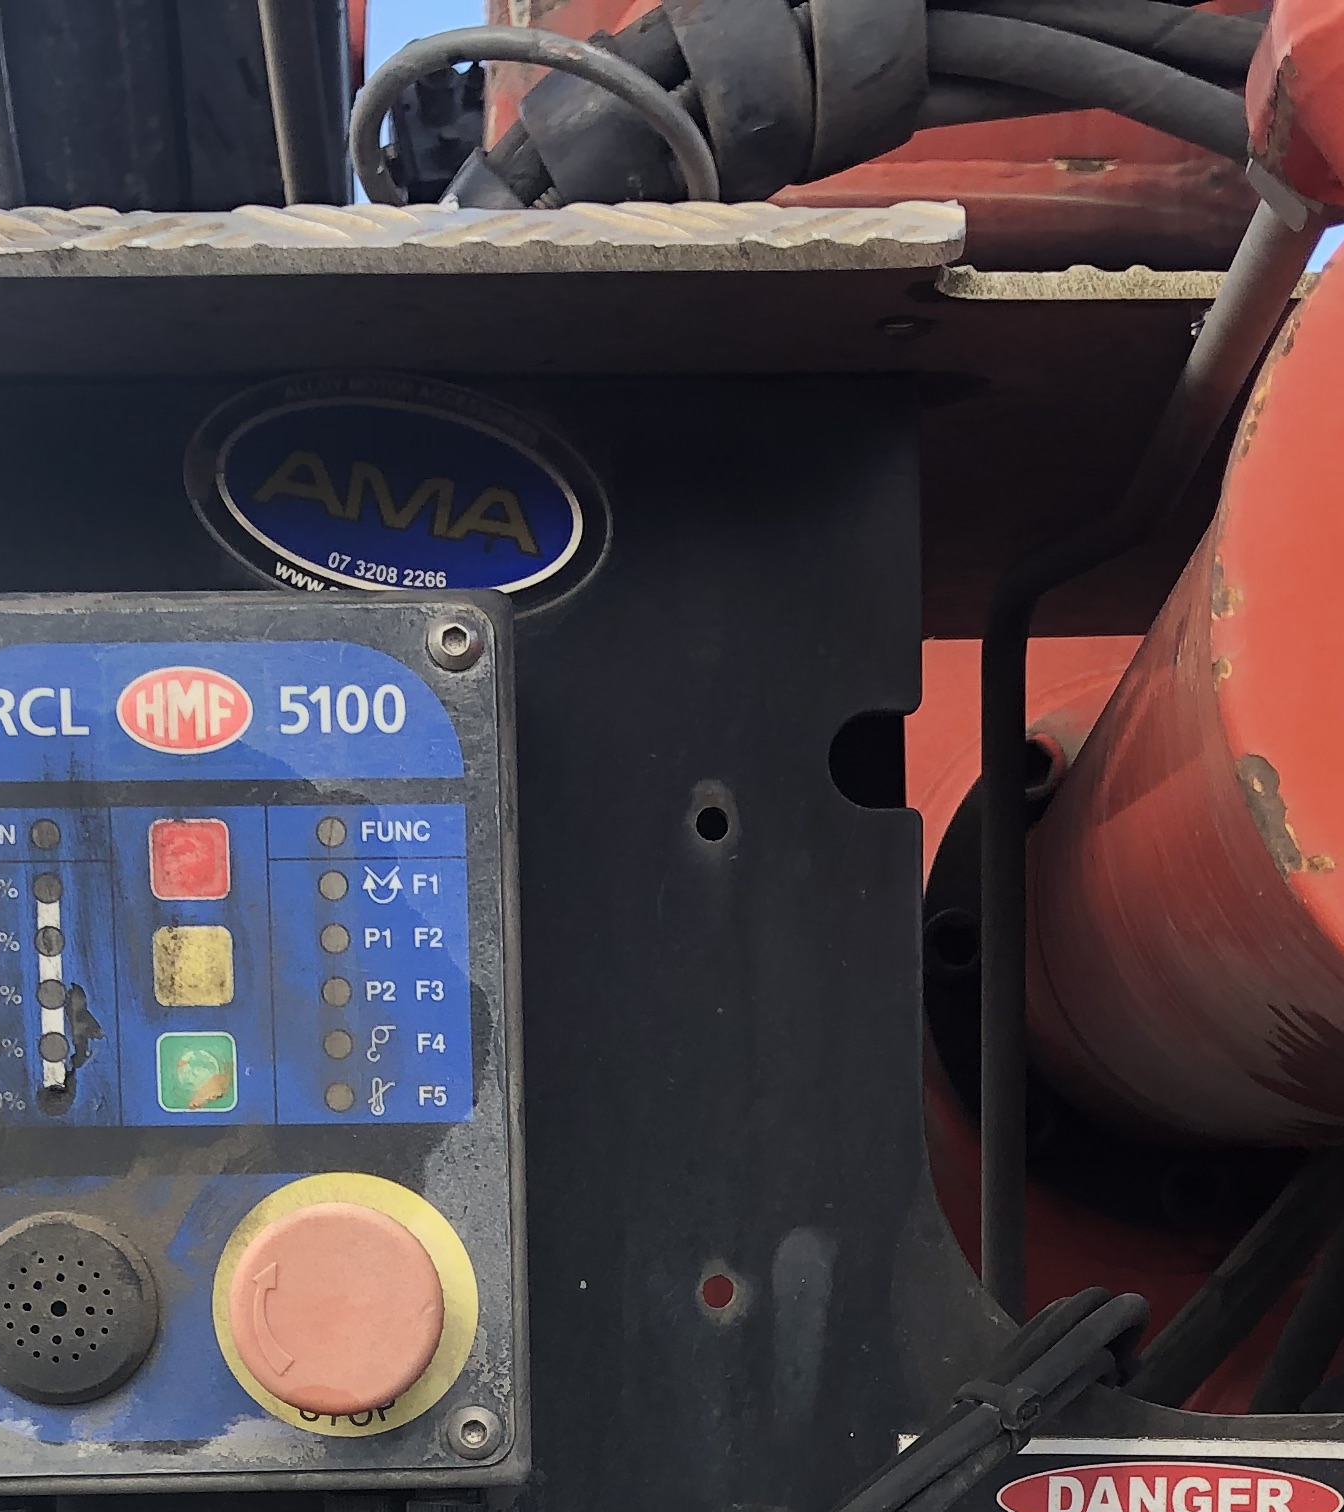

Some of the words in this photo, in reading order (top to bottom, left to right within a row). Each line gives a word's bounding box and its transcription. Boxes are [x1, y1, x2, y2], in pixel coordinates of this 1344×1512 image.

[252, 451, 542, 557] AMA
[327, 551, 352, 572] 07
[354, 558, 398, 584] 3208
[403, 569, 448, 589] 2266
[134, 678, 237, 741] HMF
[279, 684, 407, 735] 5100
[361, 821, 431, 843] FUNC
[412, 873, 440, 895] F1
[364, 927, 392, 949] P1
[414, 927, 443, 948] F2
[366, 980, 397, 1002] P2
[416, 979, 445, 1001] F3
[417, 1033, 447, 1054] F4
[418, 1085, 448, 1107] F5
